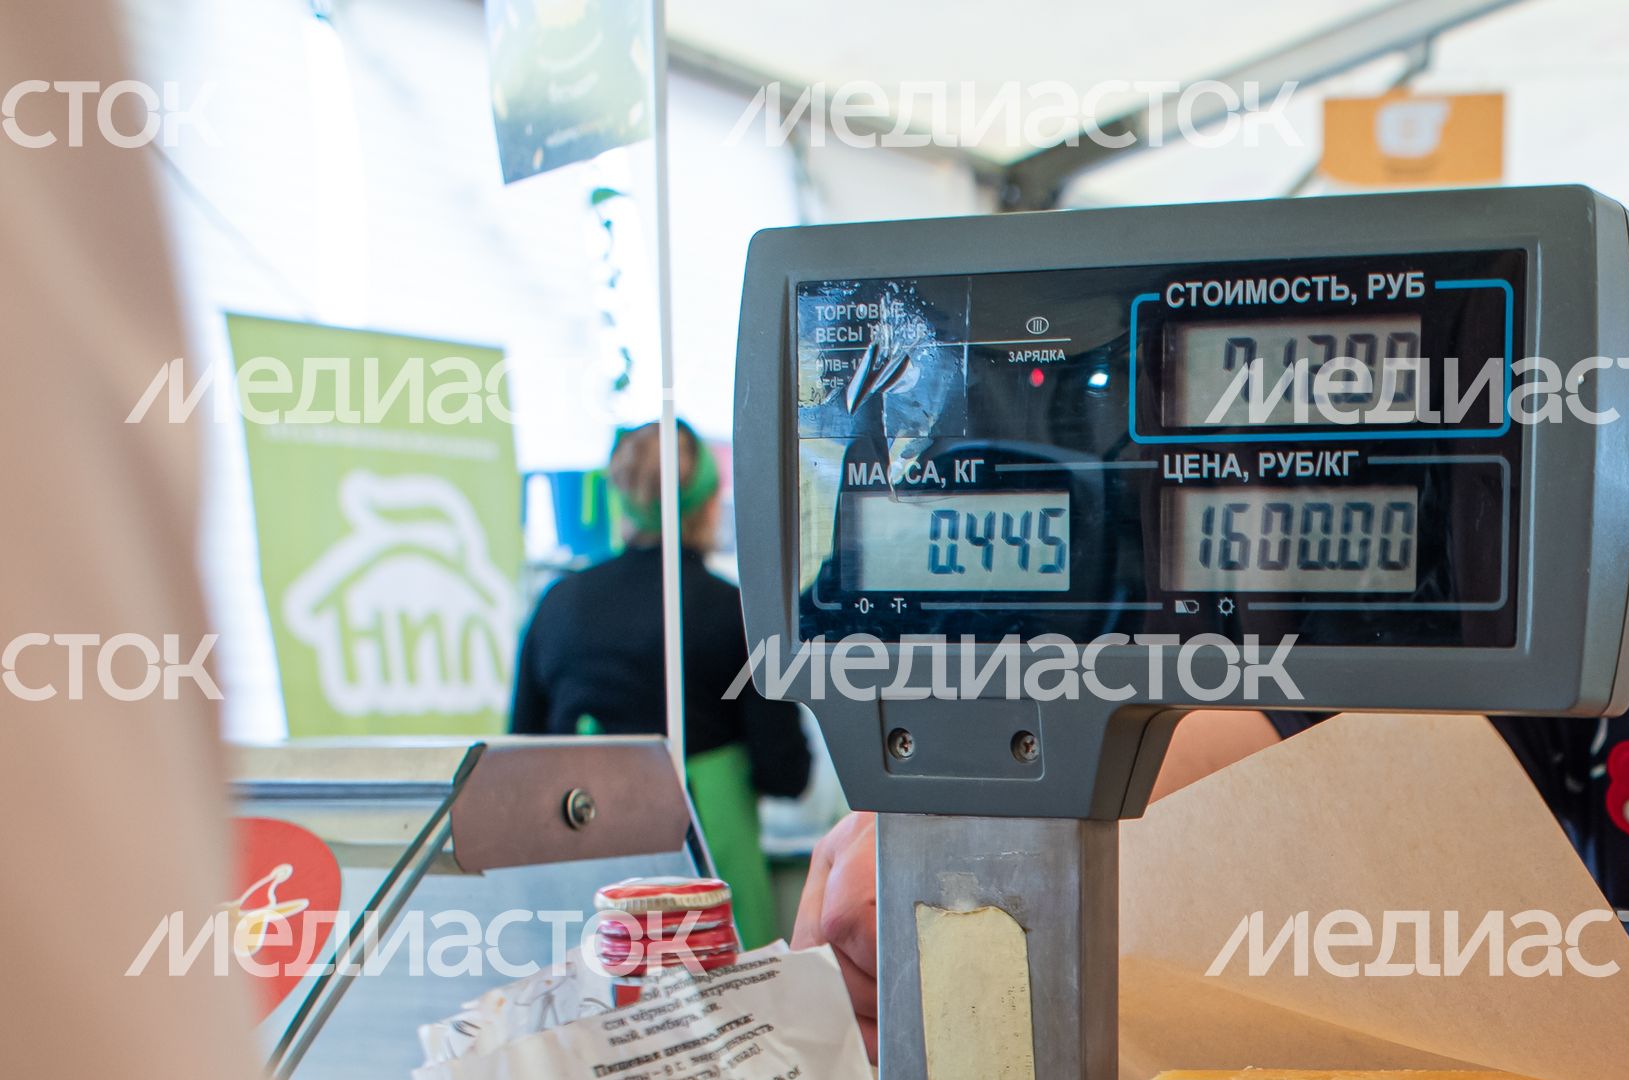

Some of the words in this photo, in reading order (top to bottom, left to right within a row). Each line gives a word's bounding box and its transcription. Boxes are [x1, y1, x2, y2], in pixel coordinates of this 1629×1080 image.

[1166, 276, 1357, 309] СТОИМОСТЬ,
[1368, 272, 1426, 301] РУБ
[815, 326, 863, 343] ВЕСЫ
[1008, 348, 1066, 364] ЗАРЯДКА
[848, 459, 946, 488] МАССА,
[954, 459, 985, 483] КГ
[1163, 452, 1249, 484] ЦЕНА,
[1259, 450, 1359, 478] РУБ/КГ
[927, 508, 1067, 575] 0.445
[1199, 501, 1415, 571] 1600.00
